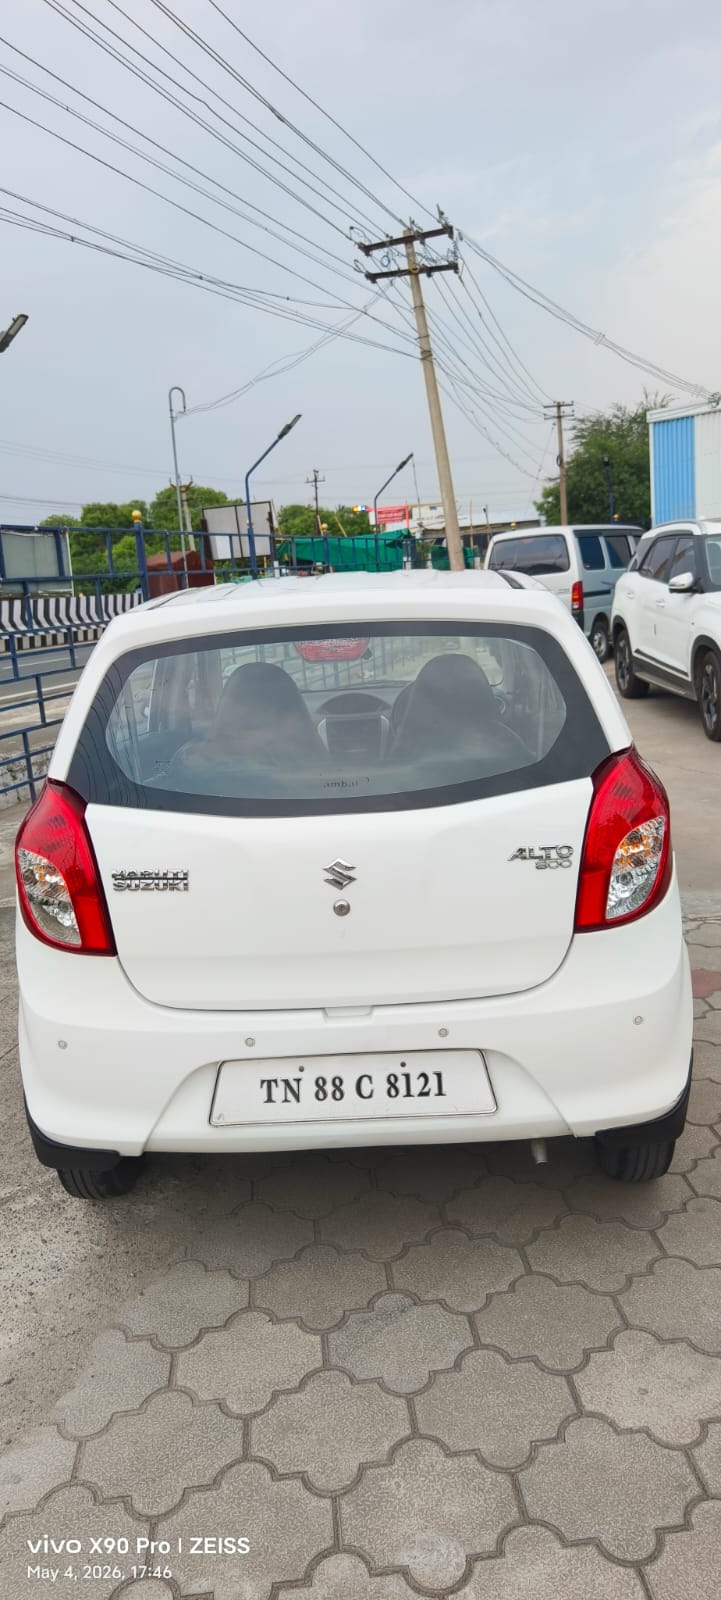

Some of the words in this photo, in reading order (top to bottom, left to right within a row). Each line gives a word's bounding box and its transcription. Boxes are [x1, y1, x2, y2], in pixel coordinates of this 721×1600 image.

[506, 844, 574, 862] ALTO
[535, 859, 573, 870] 800
[111, 868, 189, 880] MARUTI
[112, 879, 189, 892] SUZUKI
[259, 1077, 302, 1104] TN
[314, 1076, 345, 1102] 88
[355, 1073, 375, 1100] C
[386, 1071, 448, 1099] 8121
